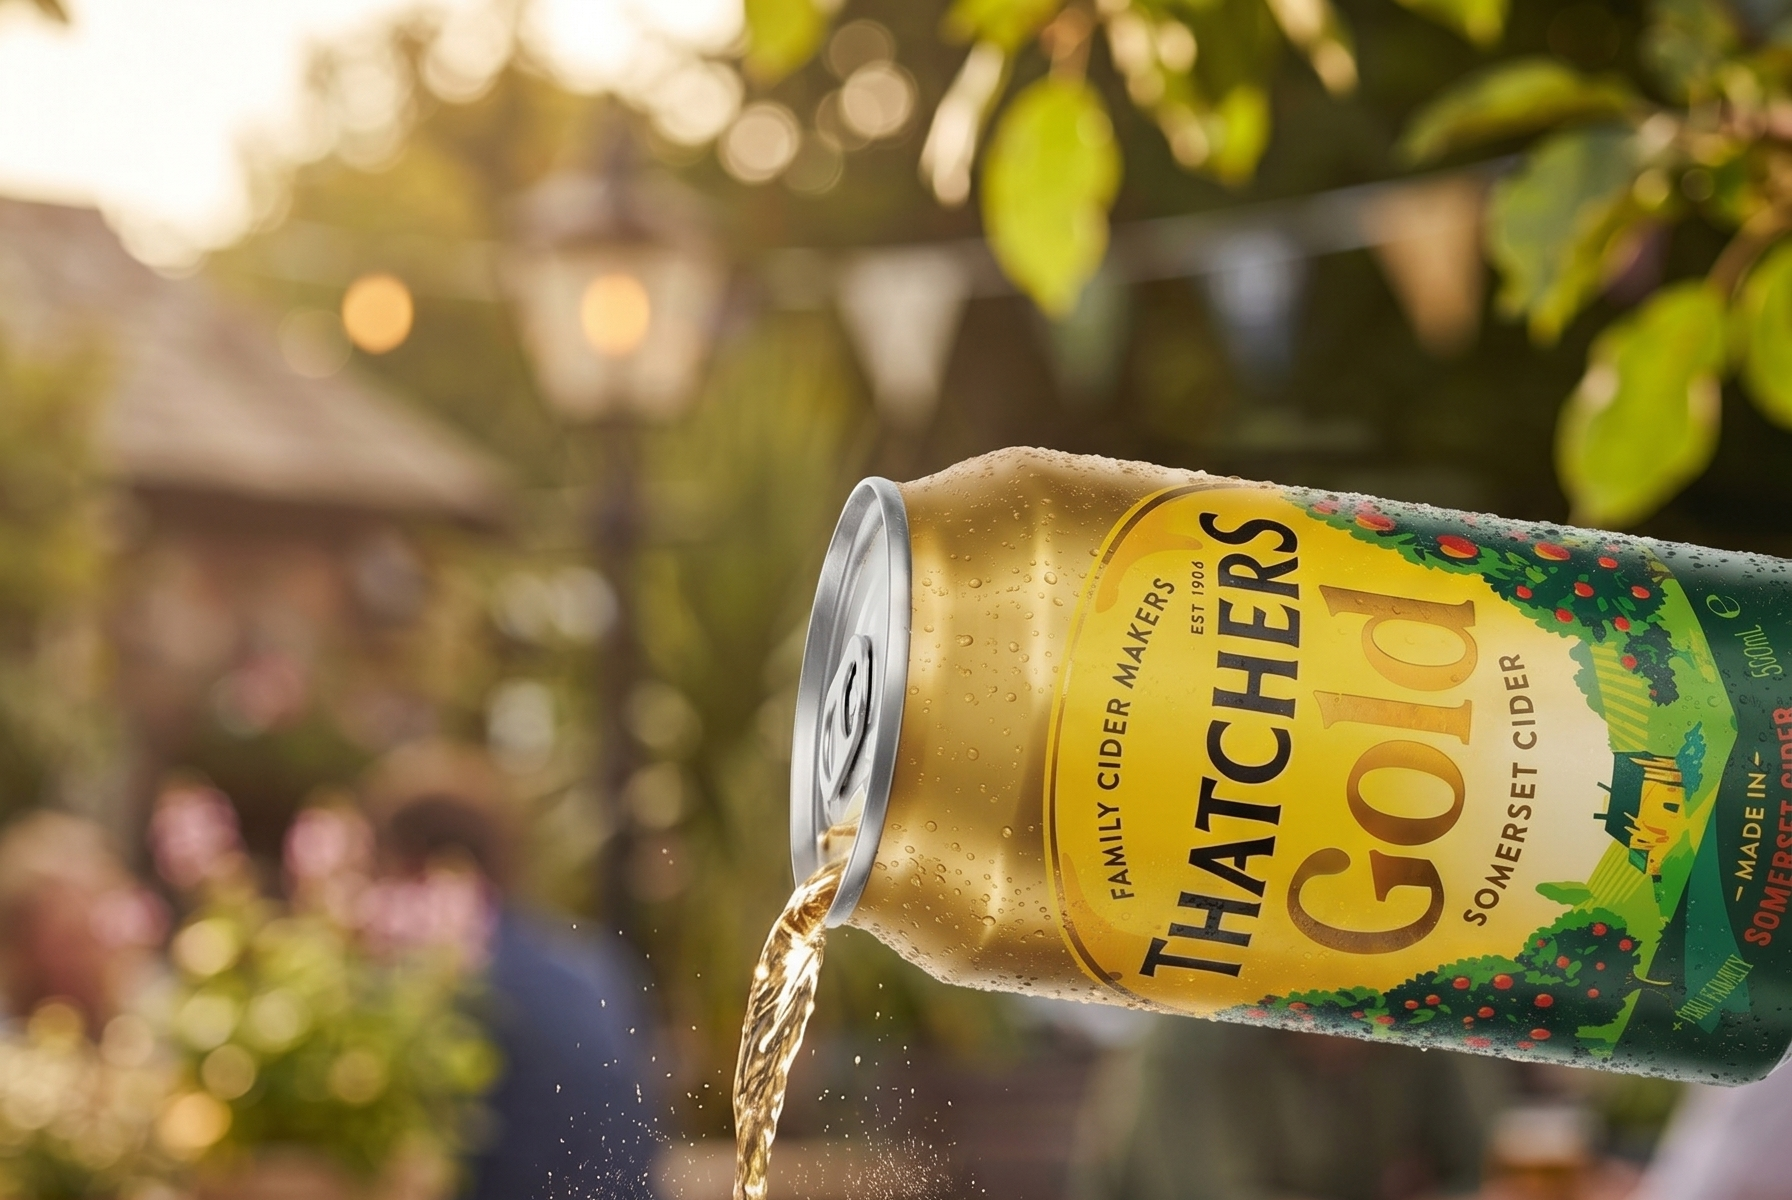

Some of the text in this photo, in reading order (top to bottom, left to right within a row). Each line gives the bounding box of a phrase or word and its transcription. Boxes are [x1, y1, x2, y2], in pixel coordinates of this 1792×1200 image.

[1097, 578, 1175, 900] FAMILY CIDER MAKERS
[1139, 511, 1301, 978] THATCHERS
[1190, 561, 1205, 635] EST 1906
[1287, 584, 1478, 955] Gold
[1463, 653, 1538, 927] SOMERSET CIDER
[1734, 772, 1766, 881] MADE IN
